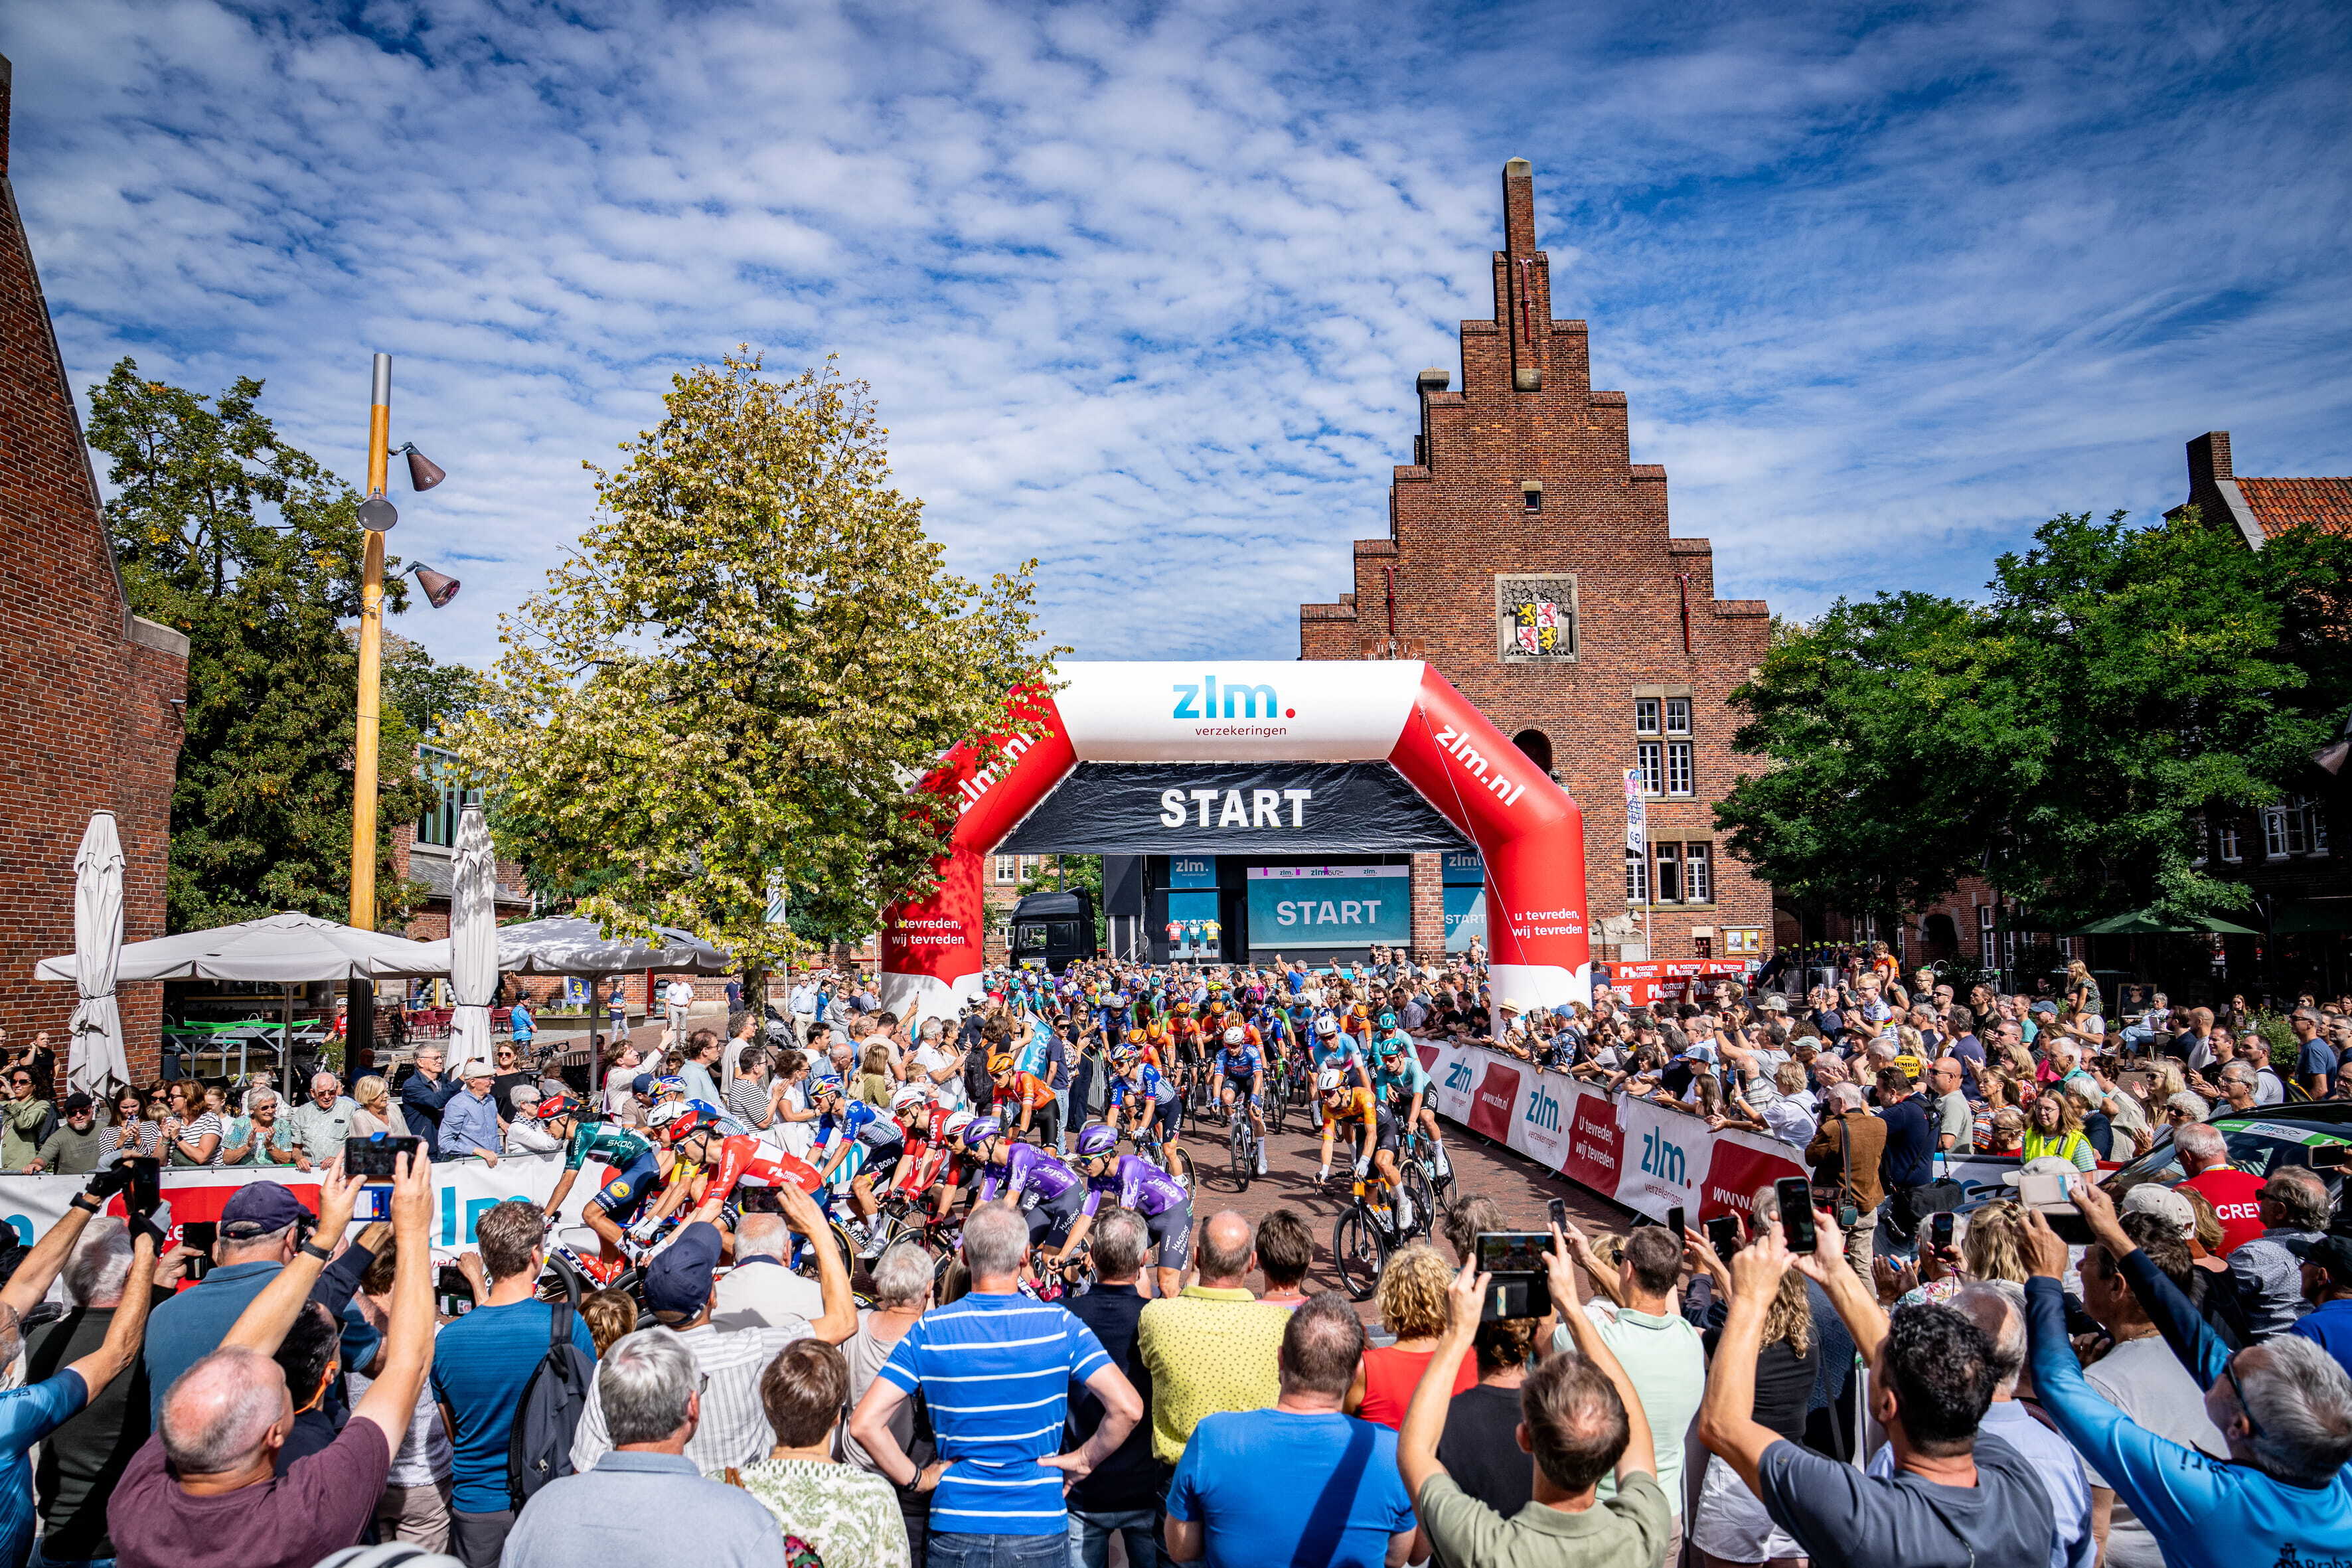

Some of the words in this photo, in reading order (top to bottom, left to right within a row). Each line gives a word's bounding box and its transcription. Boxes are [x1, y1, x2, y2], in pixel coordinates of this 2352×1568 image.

[1173, 675, 1296, 718] zlm.
[1195, 725, 1287, 737] verzekeringen
[1434, 724, 1526, 807] zlm.nl
[1160, 789, 1311, 827] START
[1176, 859, 1209, 872] zlm.
[1277, 900, 1381, 925] START
[1445, 914, 1486, 925] START
[1526, 908, 1580, 920] tevreden,
[905, 918, 962, 930] tevreden,
[1512, 926, 1530, 939] wij
[1534, 923, 1583, 935] tevreden
[892, 933, 907, 947] wij
[911, 933, 965, 944] tevreden
[1482, 1091, 1509, 1111] www.zlm.nl
[1526, 1084, 1562, 1134] zlm.
[1528, 1130, 1557, 1148] verzekeringen
[1579, 1115, 1585, 1130] U
[1585, 1119, 1614, 1145] tevreden,
[878, 1156, 898, 1170] BORA
[1575, 1140, 1587, 1159] wij
[1587, 1146, 1614, 1170] tevreden
[1641, 1125, 1691, 1190] zlm.
[1037, 1166, 1068, 1182] Jayco
[1146, 1178, 1178, 1197] Jayco
[1644, 1182, 1683, 1206] verzekeringen
[599, 1191, 617, 1208] TREK
[1060, 1208, 1079, 1230] HAGENS
[1172, 1224, 1189, 1251] HAGENS
[558, 1247, 605, 1289] TREK
